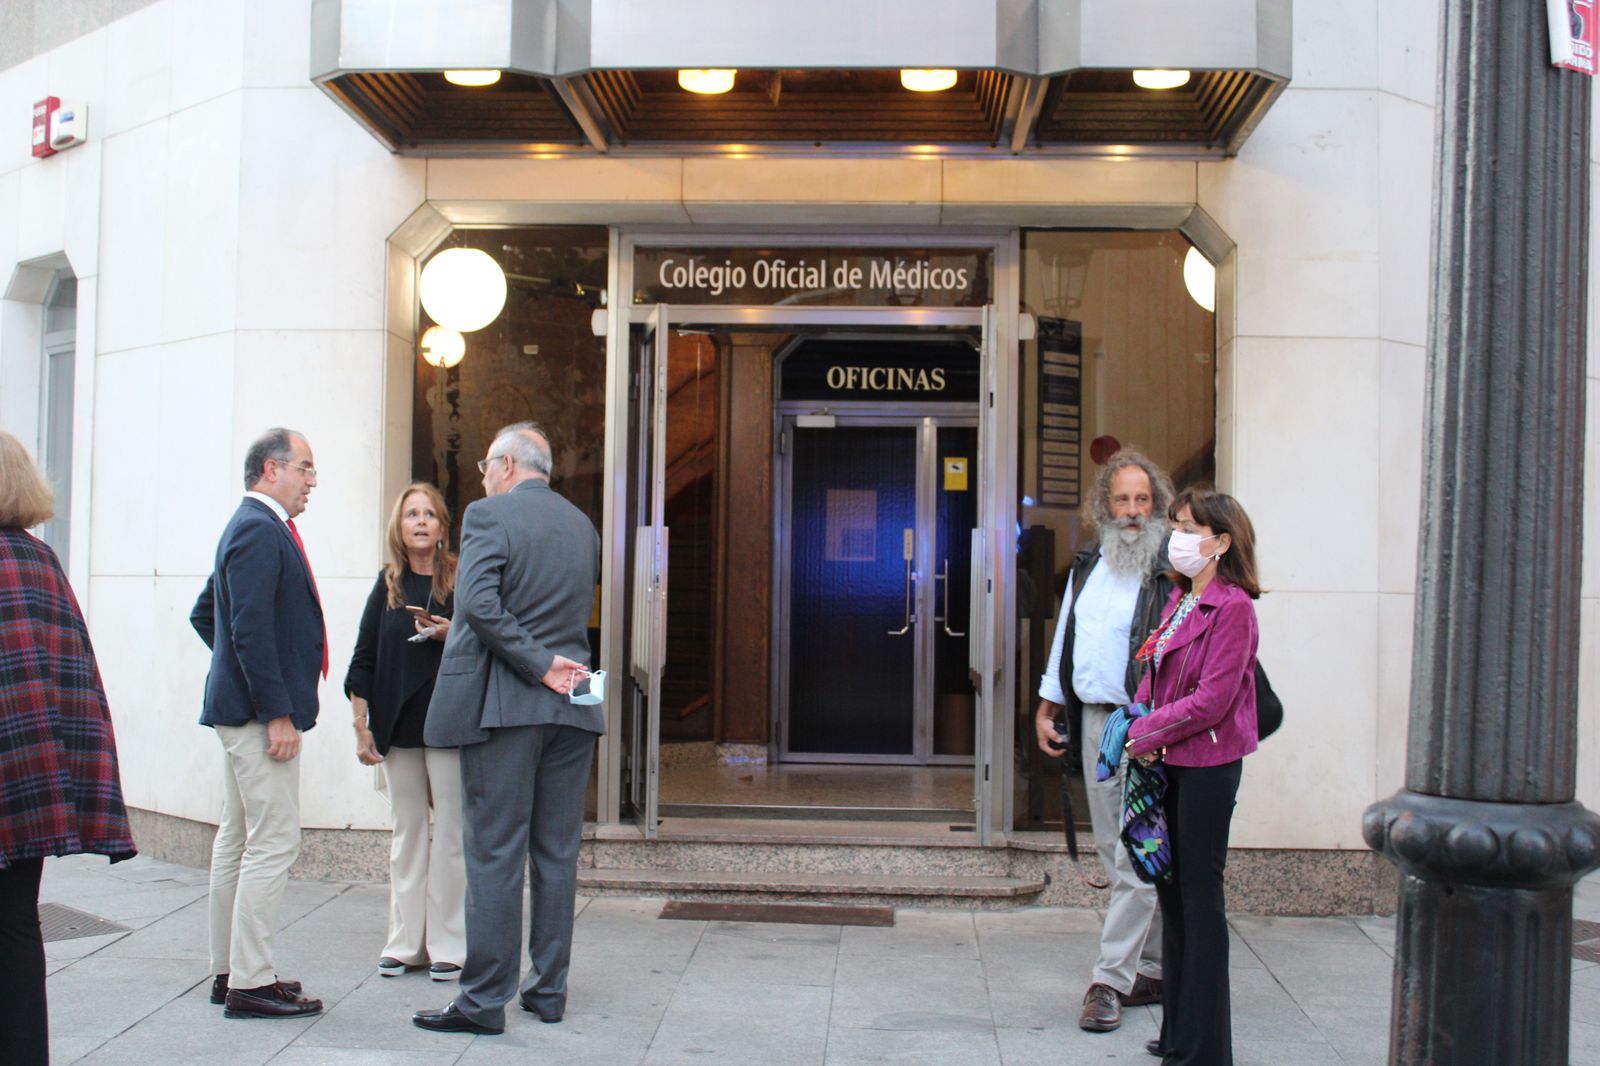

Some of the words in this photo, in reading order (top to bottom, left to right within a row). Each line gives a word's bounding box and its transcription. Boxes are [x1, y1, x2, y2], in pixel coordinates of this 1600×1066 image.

[659, 259, 746, 294] Colegio
[753, 259, 826, 288] Oficial
[833, 261, 863, 289] de
[869, 260, 968, 290] Médicos
[826, 366, 946, 391] OFICINAS
